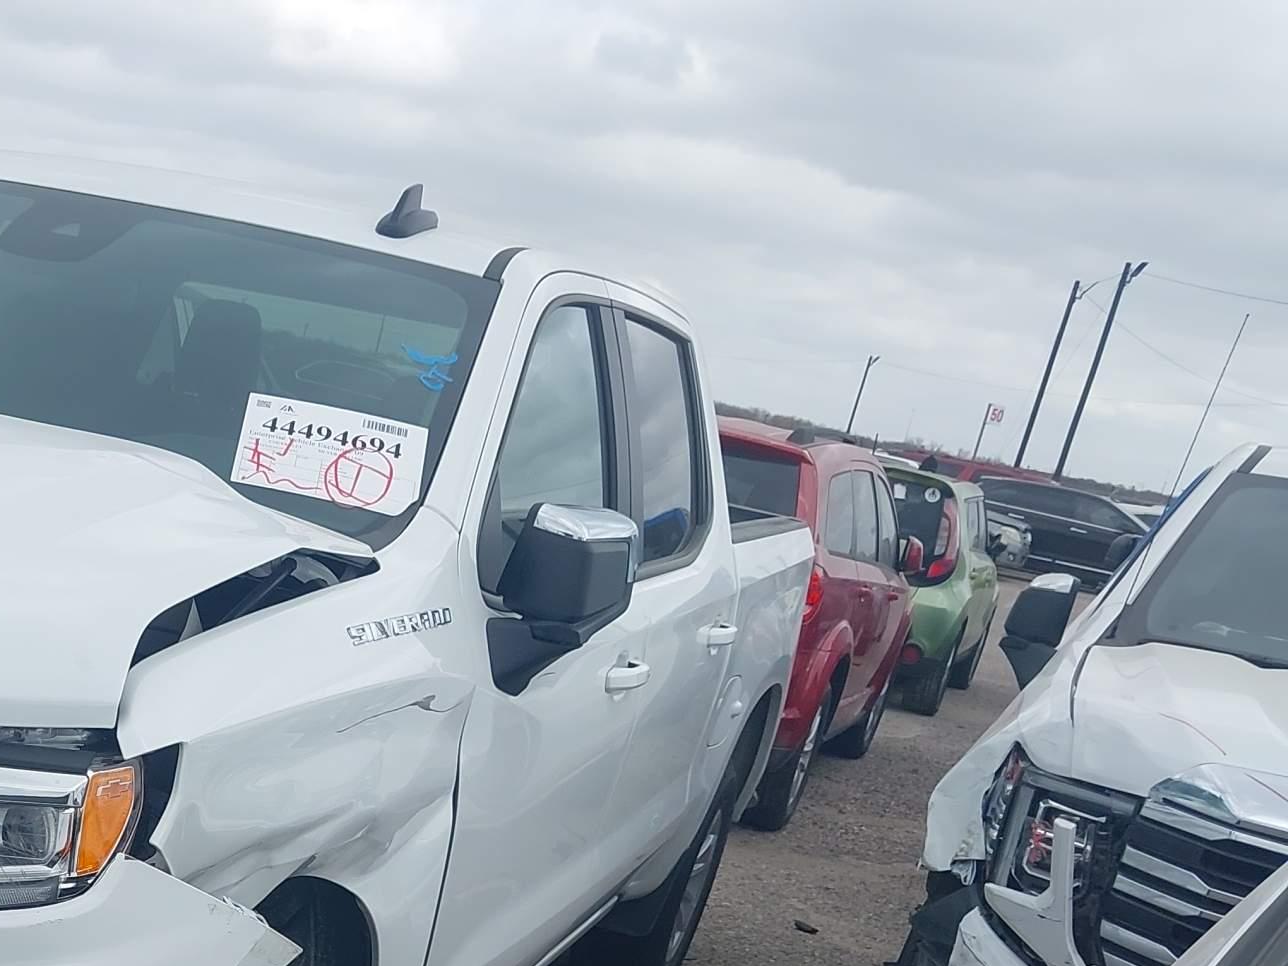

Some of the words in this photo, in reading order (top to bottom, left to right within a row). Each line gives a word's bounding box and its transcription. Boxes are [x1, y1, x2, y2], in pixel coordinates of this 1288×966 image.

[990, 407, 1005, 423] 50
[262, 416, 402, 459] 44494694
[346, 606, 452, 647] SILVERADO
